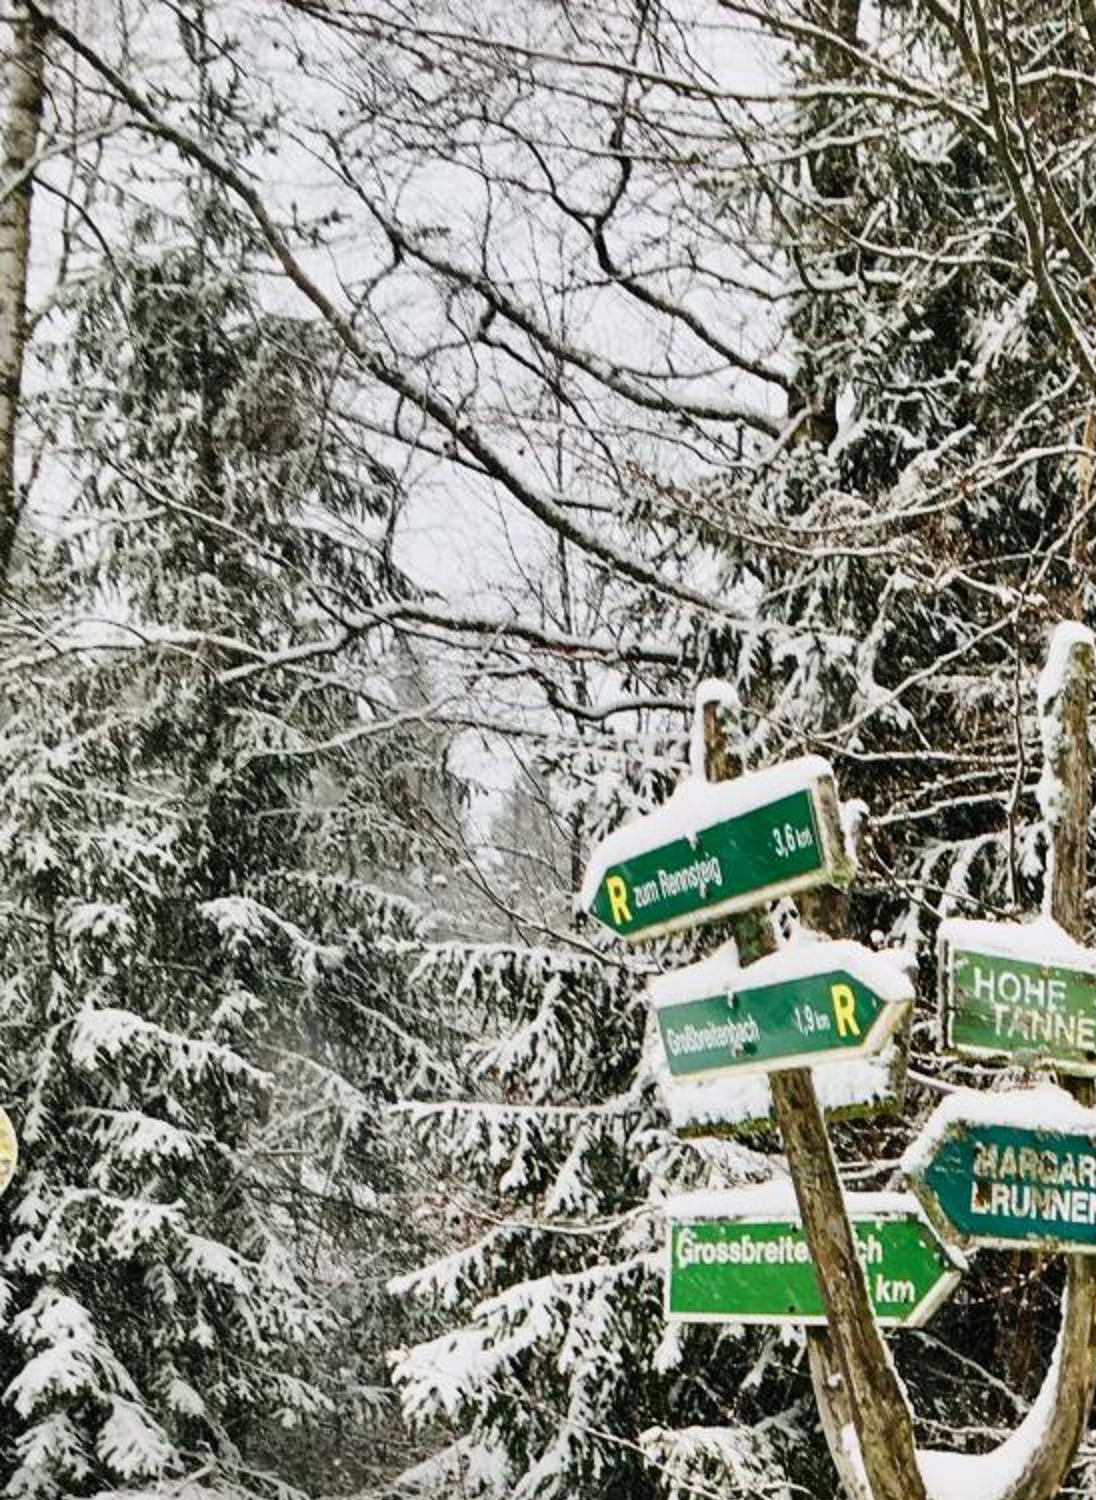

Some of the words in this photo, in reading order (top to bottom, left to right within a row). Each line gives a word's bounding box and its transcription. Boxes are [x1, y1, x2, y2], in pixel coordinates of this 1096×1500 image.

[607, 875, 632, 925] R
[633, 880, 660, 908] zum
[772, 823, 796, 858] 3,6
[795, 828, 813, 848] km
[813, 1010, 831, 1031] km
[831, 984, 861, 1037] R
[974, 967, 1067, 1011] HOHE
[992, 1003, 1096, 1051] TANNE
[677, 1233, 883, 1265] Grossbreitech
[875, 1273, 916, 1303] km
